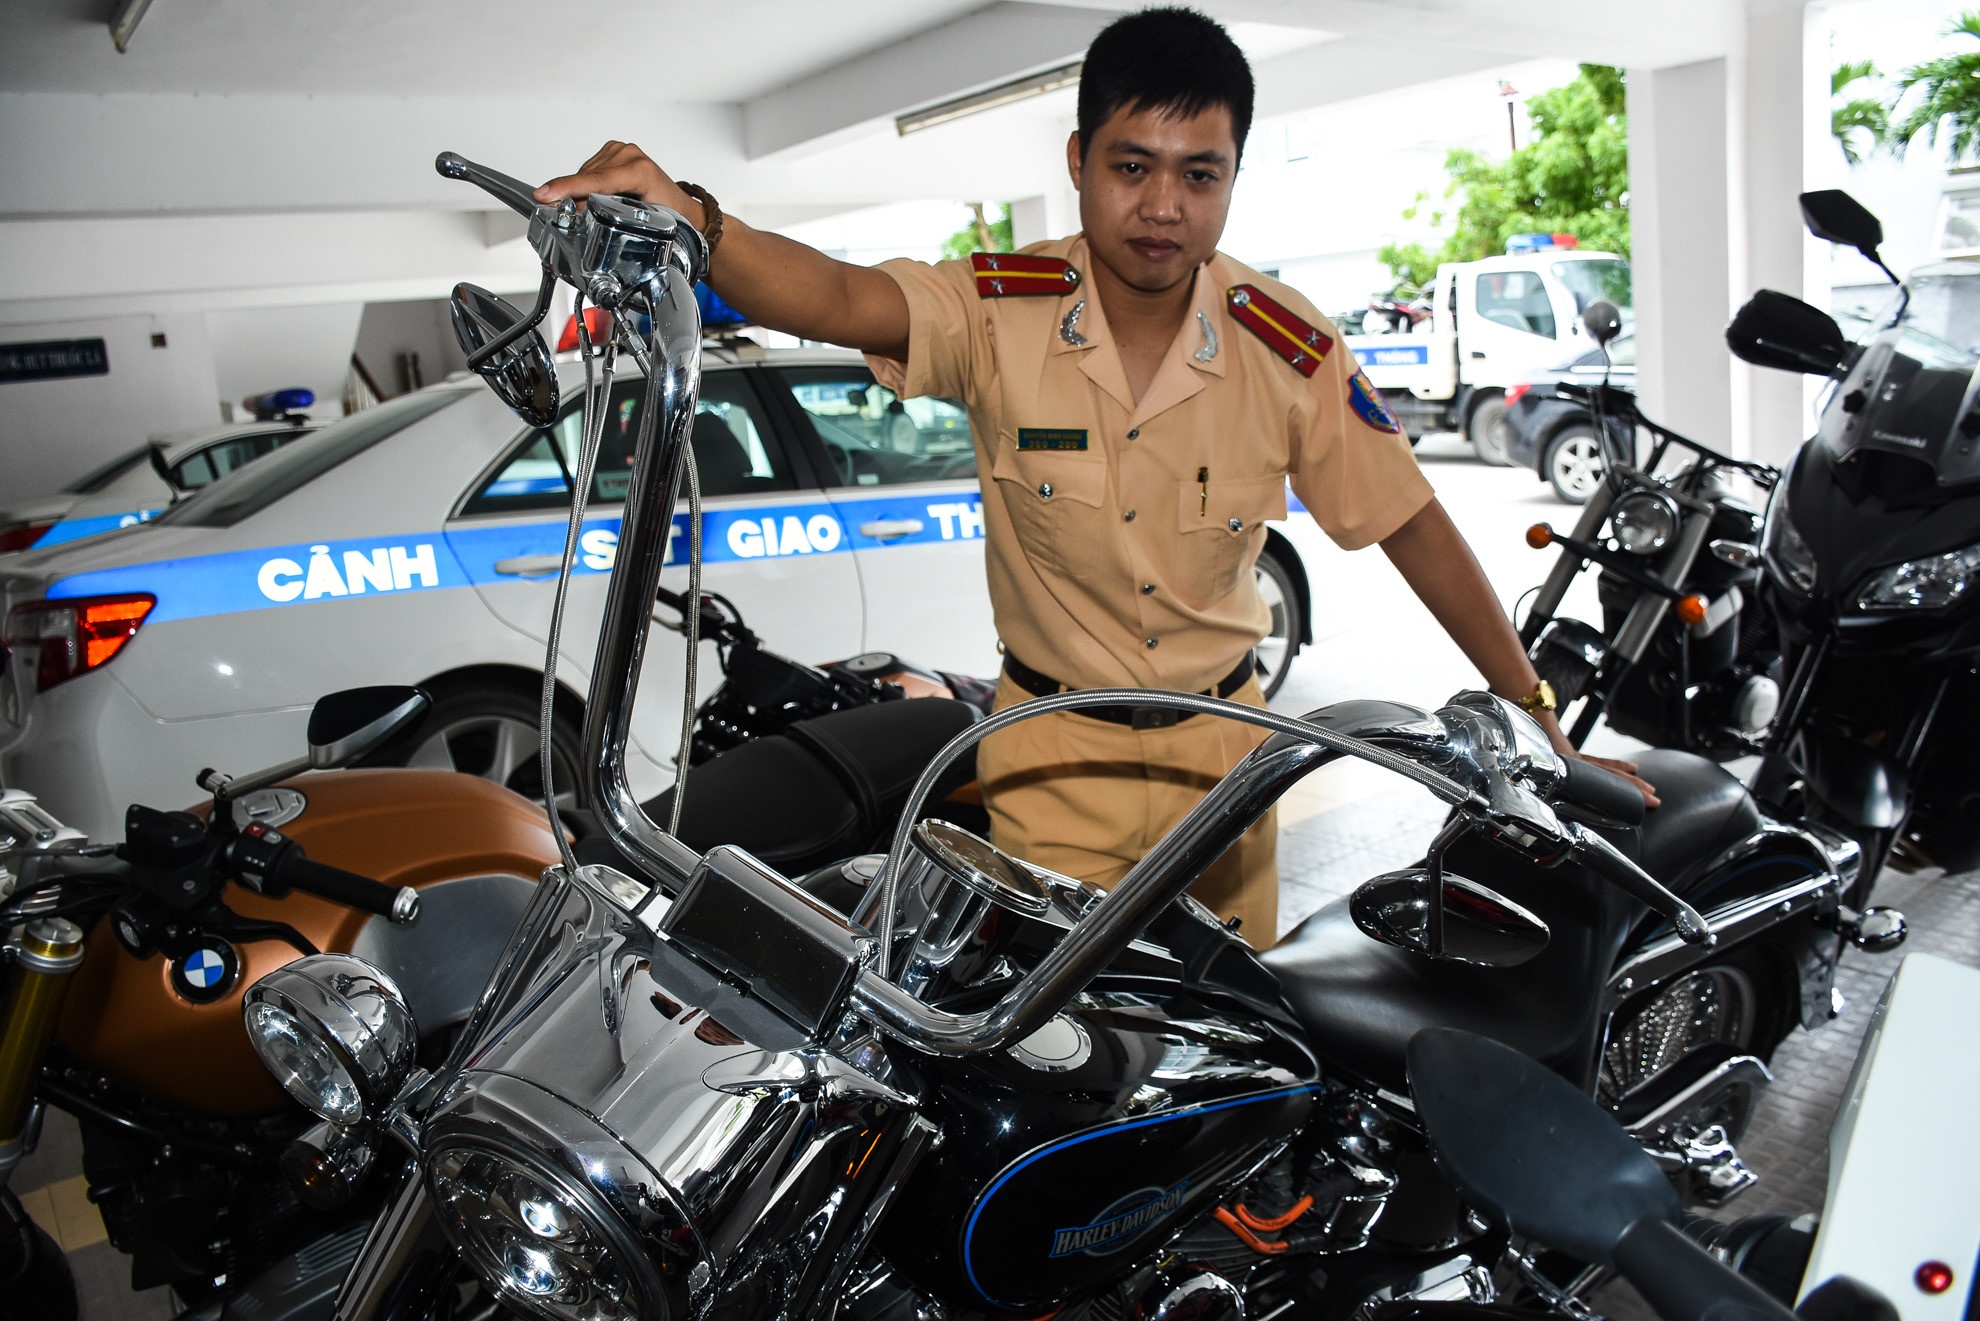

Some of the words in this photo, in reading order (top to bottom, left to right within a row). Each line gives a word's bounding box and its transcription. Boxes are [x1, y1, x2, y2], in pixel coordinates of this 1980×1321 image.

[257, 544, 439, 602] CẢNH
[581, 524, 682, 570] ST
[727, 514, 841, 558] GIAO
[927, 502, 986, 540] TH
[1055, 1186, 1184, 1255] HARLEY-DAVIDSON
